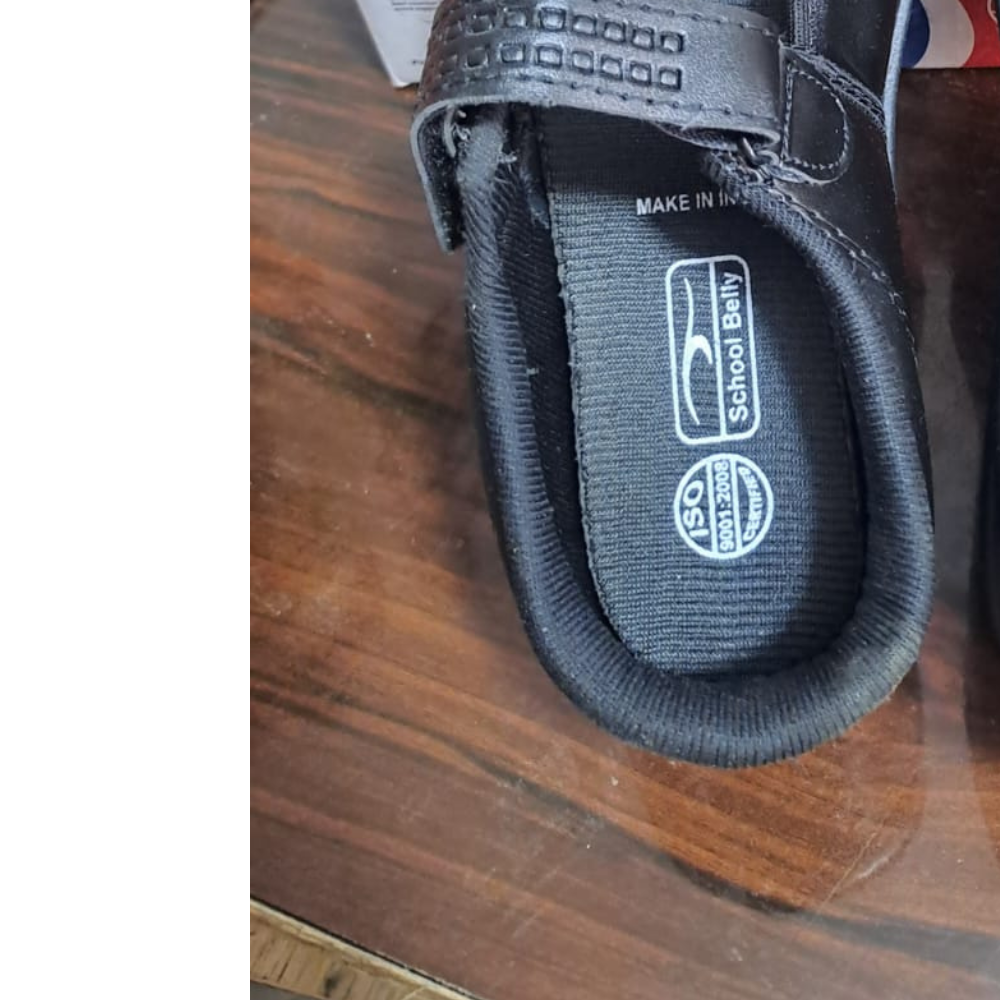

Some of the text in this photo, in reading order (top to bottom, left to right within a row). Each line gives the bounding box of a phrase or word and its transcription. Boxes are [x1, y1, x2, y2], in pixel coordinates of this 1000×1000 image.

[636, 193, 690, 216] MAKE
[696, 191, 714, 209] IN
[720, 272, 749, 423] School Belly
[682, 479, 709, 538] ISO
[713, 459, 735, 551] 9001:2008
